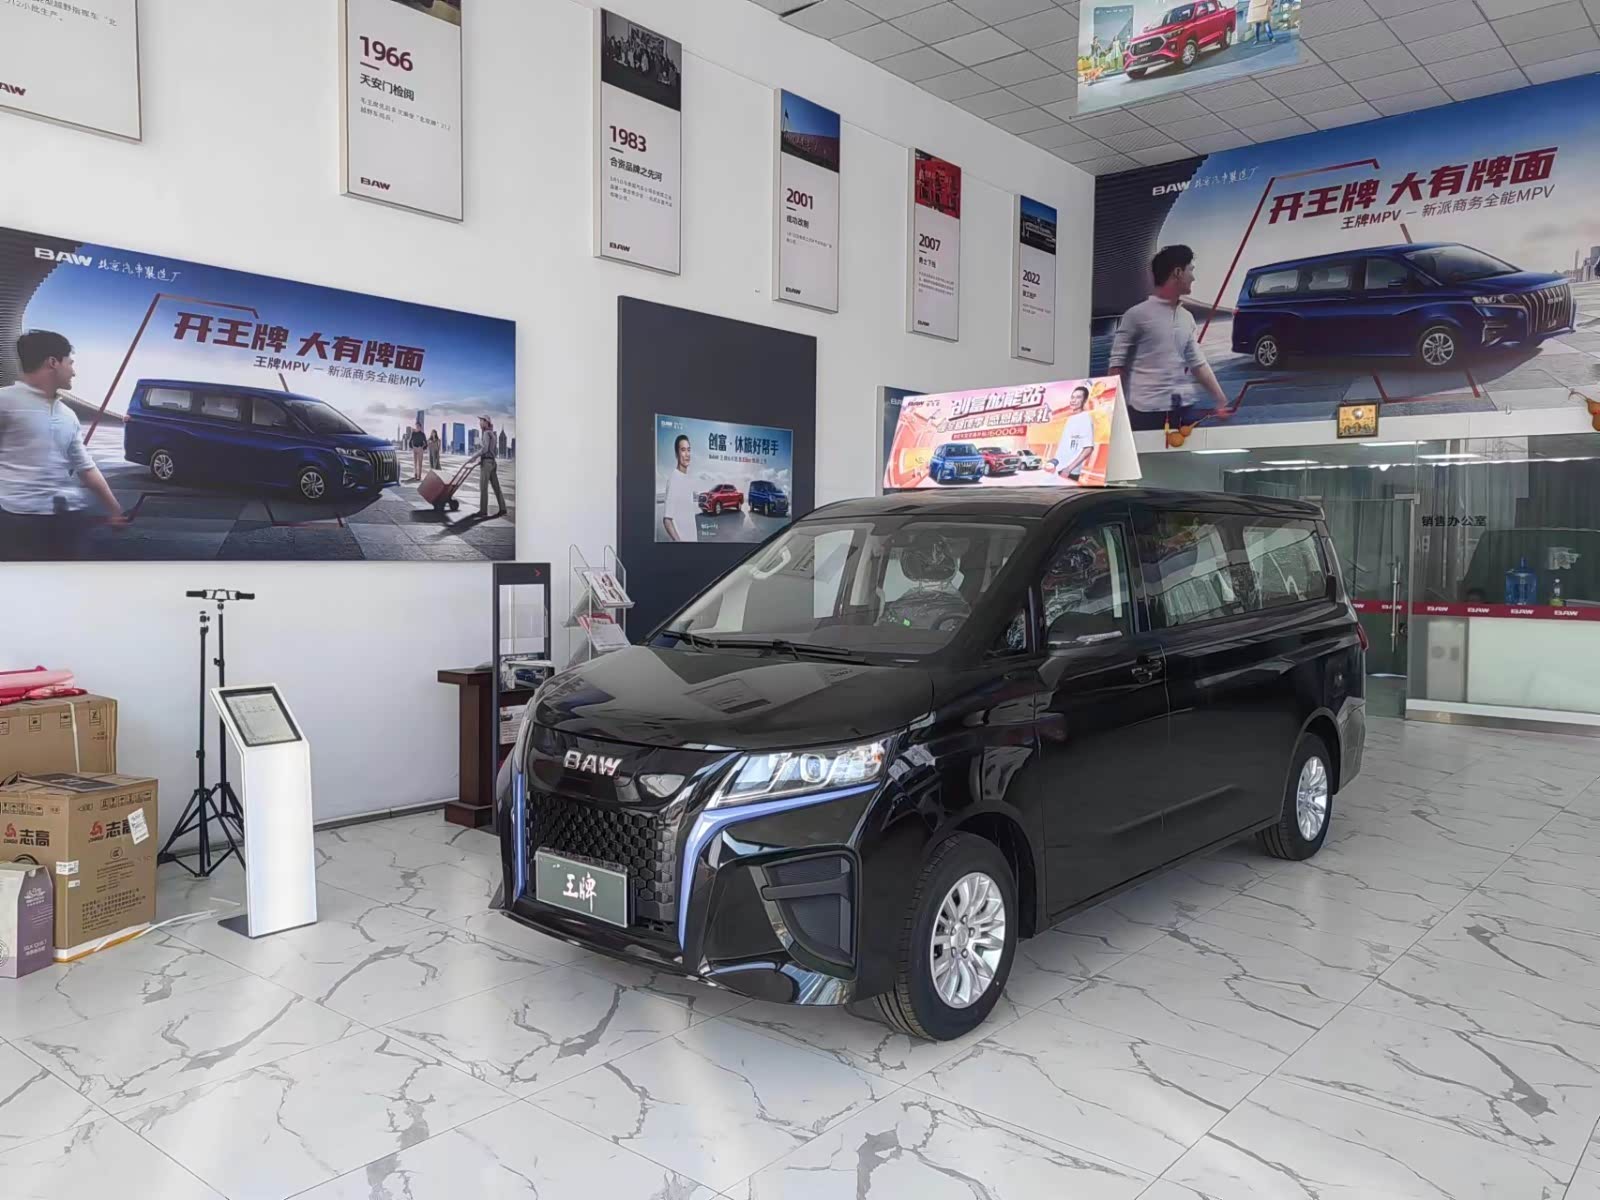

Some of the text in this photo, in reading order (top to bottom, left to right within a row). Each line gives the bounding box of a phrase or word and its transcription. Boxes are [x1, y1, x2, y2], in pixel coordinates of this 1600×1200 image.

[360, 36, 412, 71] 1966
[0, 82, 26, 96] AW
[360, 73, 414, 101] 天安门检阅
[609, 125, 646, 152] 1983
[609, 156, 663, 182] 合资品牌之先河
[361, 177, 391, 190] BAW
[1152, 181, 1191, 196] BAW
[1268, 146, 1558, 225] 开王牌 大有牌面
[786, 188, 813, 210] 2001
[1340, 184, 1555, 230] 王牌MPV 新派商务全能MPV
[609, 242, 630, 252] BAW
[919, 233, 941, 251] 2007
[34, 246, 93, 267] BAW
[1022, 269, 1040, 285] 2022
[173, 311, 425, 372] 开王牌 大有牌面
[253, 355, 425, 388] 王牌MPV 新派商务全能MPV
[951, 385, 1047, 417] 创富加能站
[1422, 515, 1487, 527] 销售办公室
[563, 750, 622, 776] BAW
[19, 829, 50, 847] 志高
[563, 872, 597, 912] 王牌
